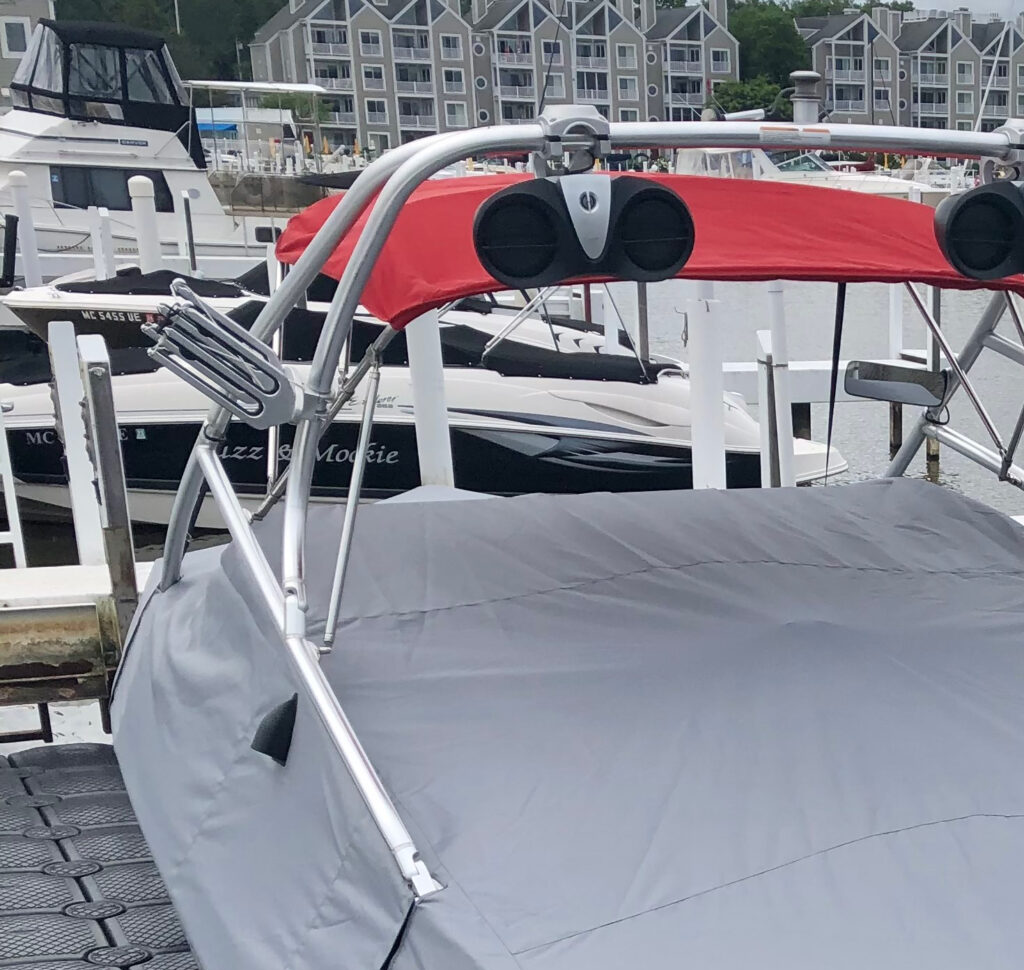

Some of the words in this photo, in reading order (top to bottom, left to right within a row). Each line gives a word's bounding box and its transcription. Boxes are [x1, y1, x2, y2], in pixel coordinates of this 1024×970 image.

[81, 310, 97, 320] MC
[99, 311, 125, 321] 5455
[127, 312, 142, 322] UE
[26, 431, 55, 445] MC
